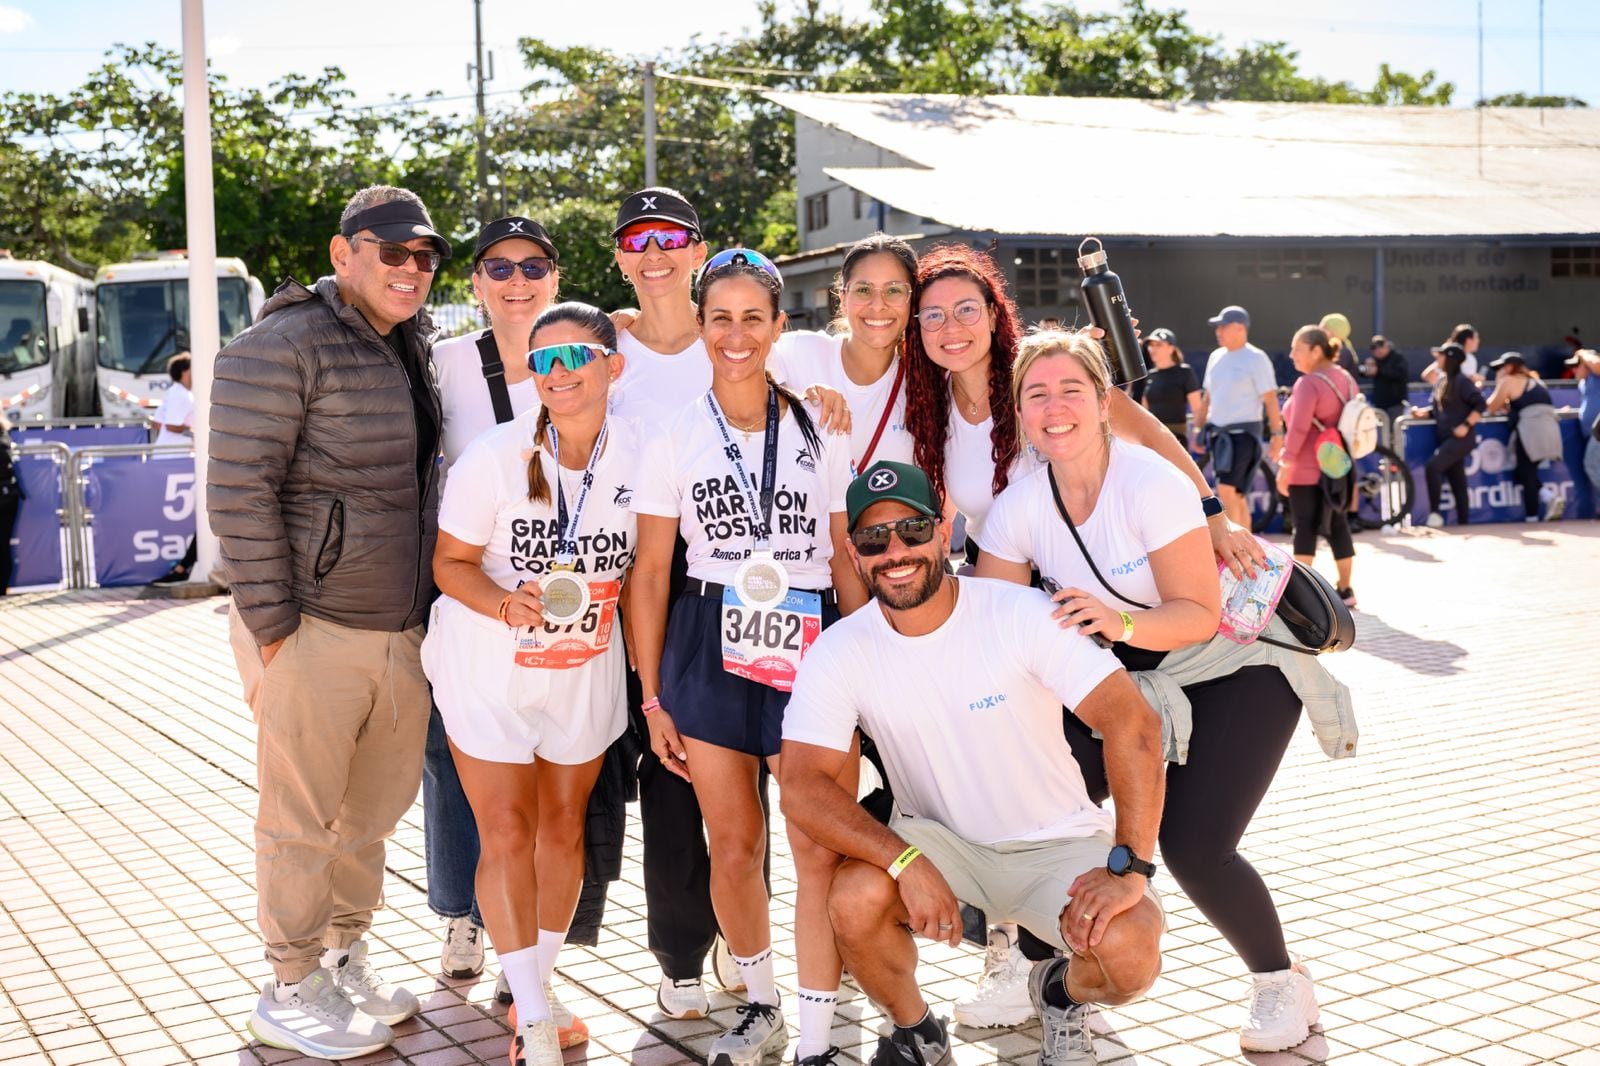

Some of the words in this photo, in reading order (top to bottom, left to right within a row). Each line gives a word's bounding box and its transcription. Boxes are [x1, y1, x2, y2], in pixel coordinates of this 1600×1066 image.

[641, 196, 658, 211] X
[508, 221, 525, 233] X
[1438, 273, 1540, 293] Montada
[874, 473, 890, 487] X
[710, 548, 741, 561] Banco
[600, 623, 611, 634] 10
[725, 608, 801, 651] 3462
